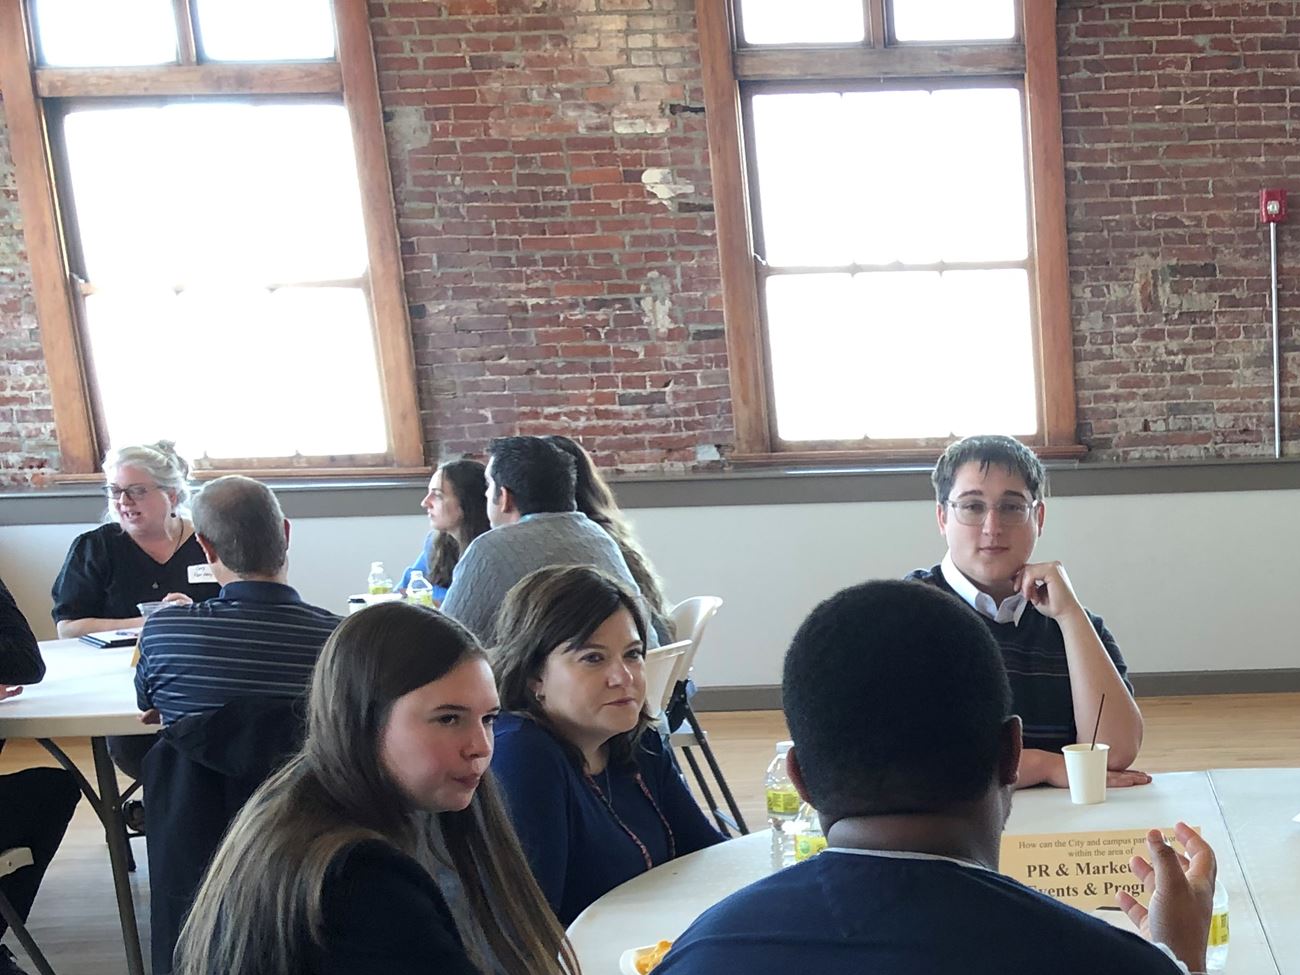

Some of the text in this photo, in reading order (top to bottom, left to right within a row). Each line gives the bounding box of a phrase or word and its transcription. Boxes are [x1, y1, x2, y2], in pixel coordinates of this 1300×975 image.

[1018, 841, 1036, 849] How
[1054, 840, 1067, 848] the
[1068, 839, 1084, 849] City
[1087, 838, 1101, 847] and
[1103, 839, 1132, 848] campus
[1068, 847, 1133, 858] within the area of
[1027, 864, 1050, 878] PR
[1055, 863, 1069, 877] &
[1083, 882, 1098, 896] &
